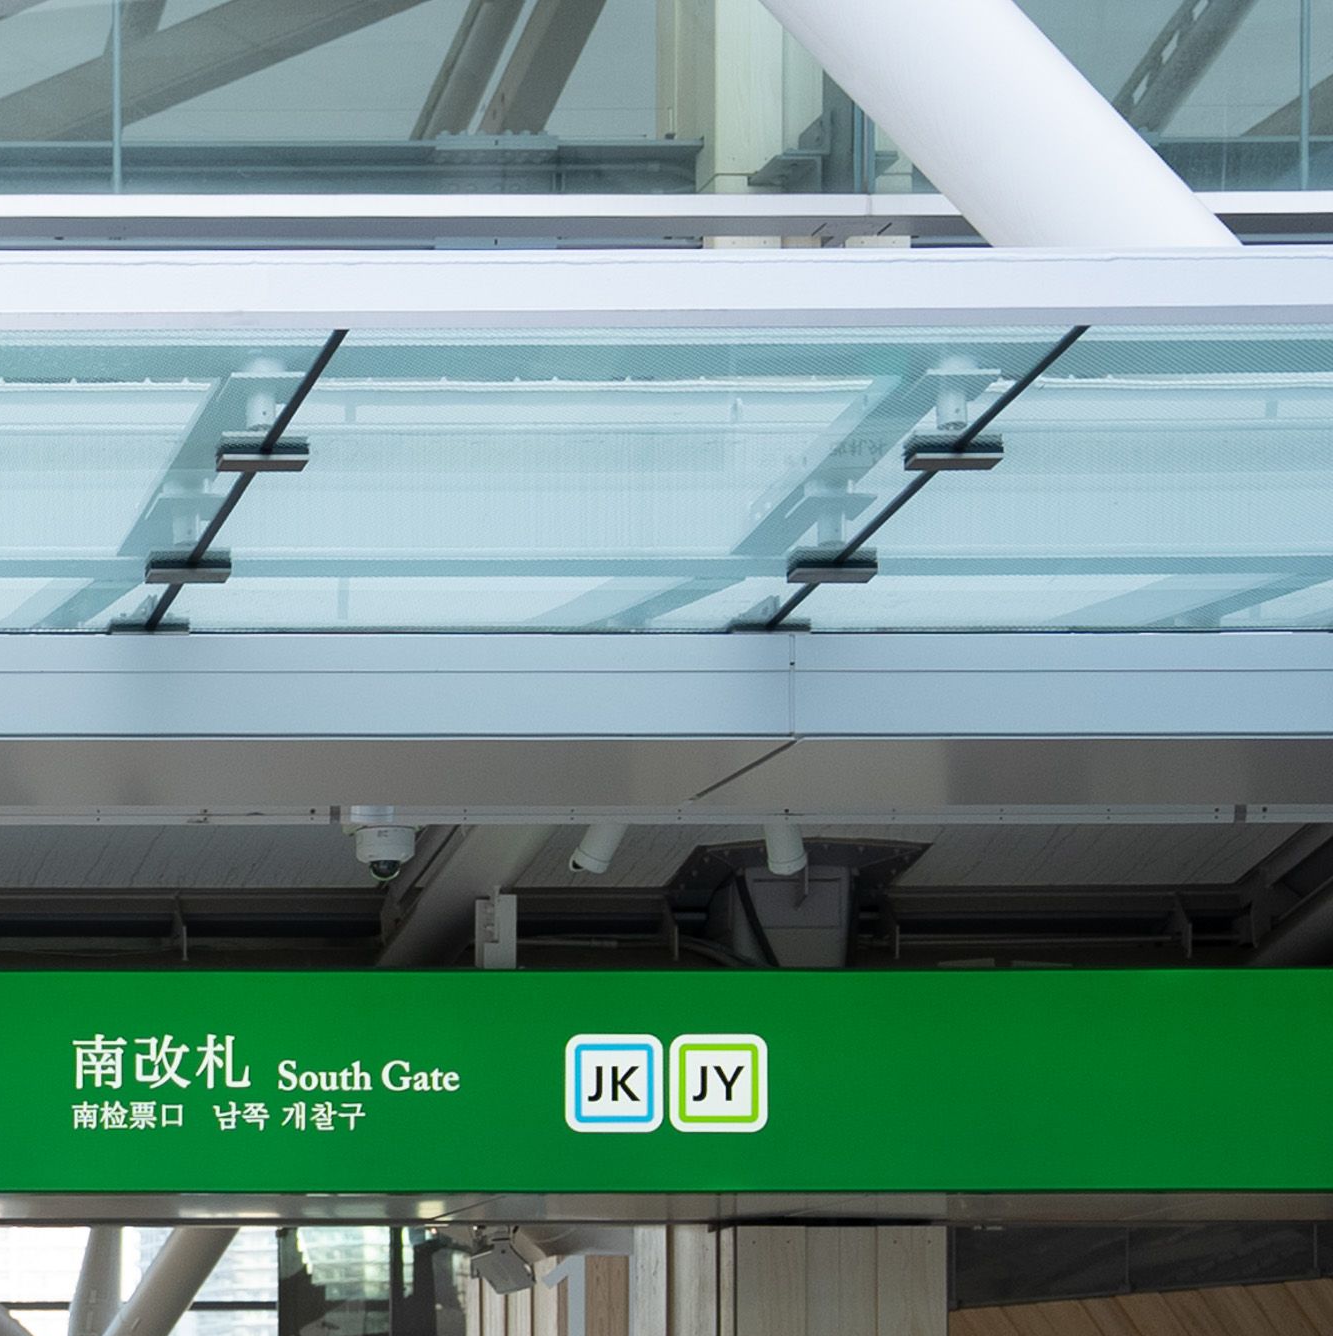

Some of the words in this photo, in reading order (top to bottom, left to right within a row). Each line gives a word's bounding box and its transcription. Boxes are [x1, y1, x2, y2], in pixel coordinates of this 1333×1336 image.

[73, 1034, 250, 1089] 南改札
[279, 1060, 372, 1091] South
[382, 1060, 459, 1091] Gate
[588, 1066, 640, 1101] JK
[693, 1066, 744, 1101] JY
[72, 1101, 182, 1130] 南检票口
[214, 1101, 270, 1131] 남쪽
[282, 1101, 365, 1131] 개찰구
